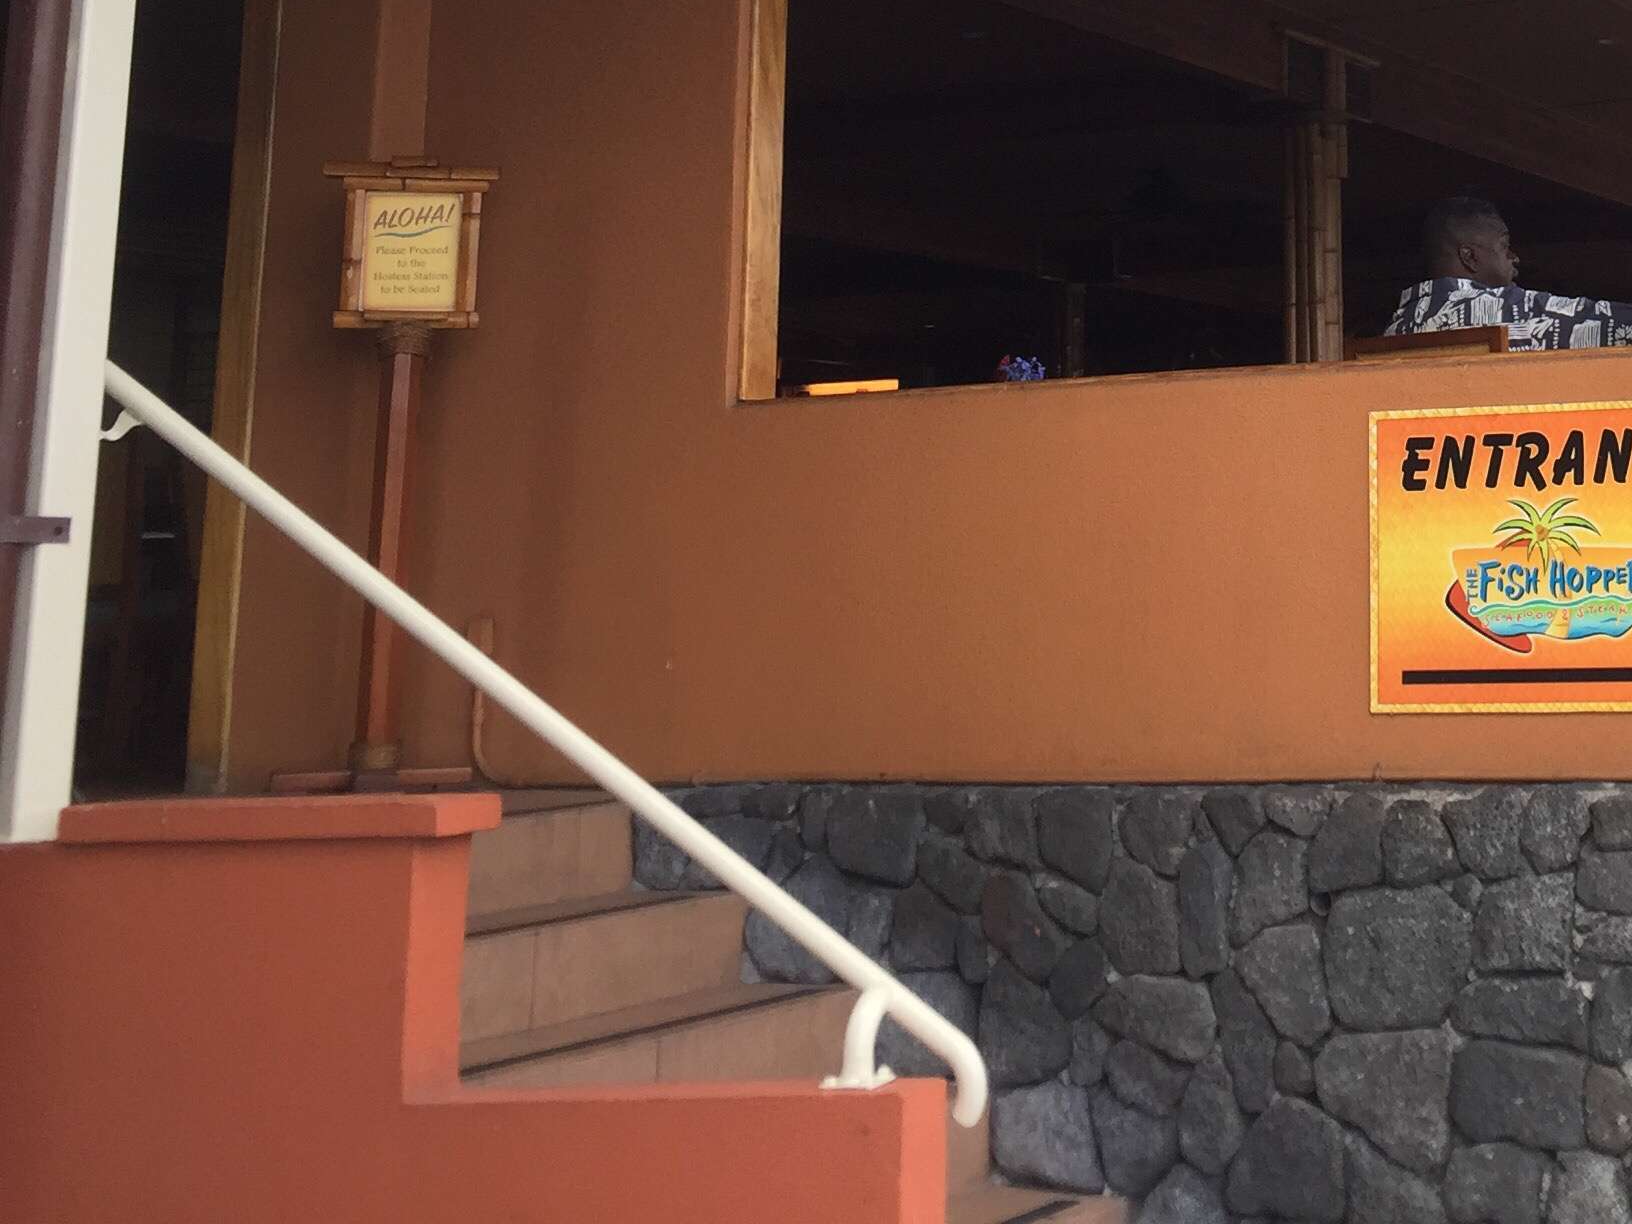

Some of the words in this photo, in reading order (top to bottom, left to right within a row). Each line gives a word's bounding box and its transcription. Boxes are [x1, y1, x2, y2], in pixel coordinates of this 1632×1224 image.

[373, 203, 455, 230] ALOHA!
[376, 246, 406, 255] Please
[409, 246, 449, 255] Proceed
[397, 259, 407, 267] to
[380, 285, 390, 294] to
[1466, 569, 1478, 600] THE
[1484, 610, 1557, 625] SEAFOOD
